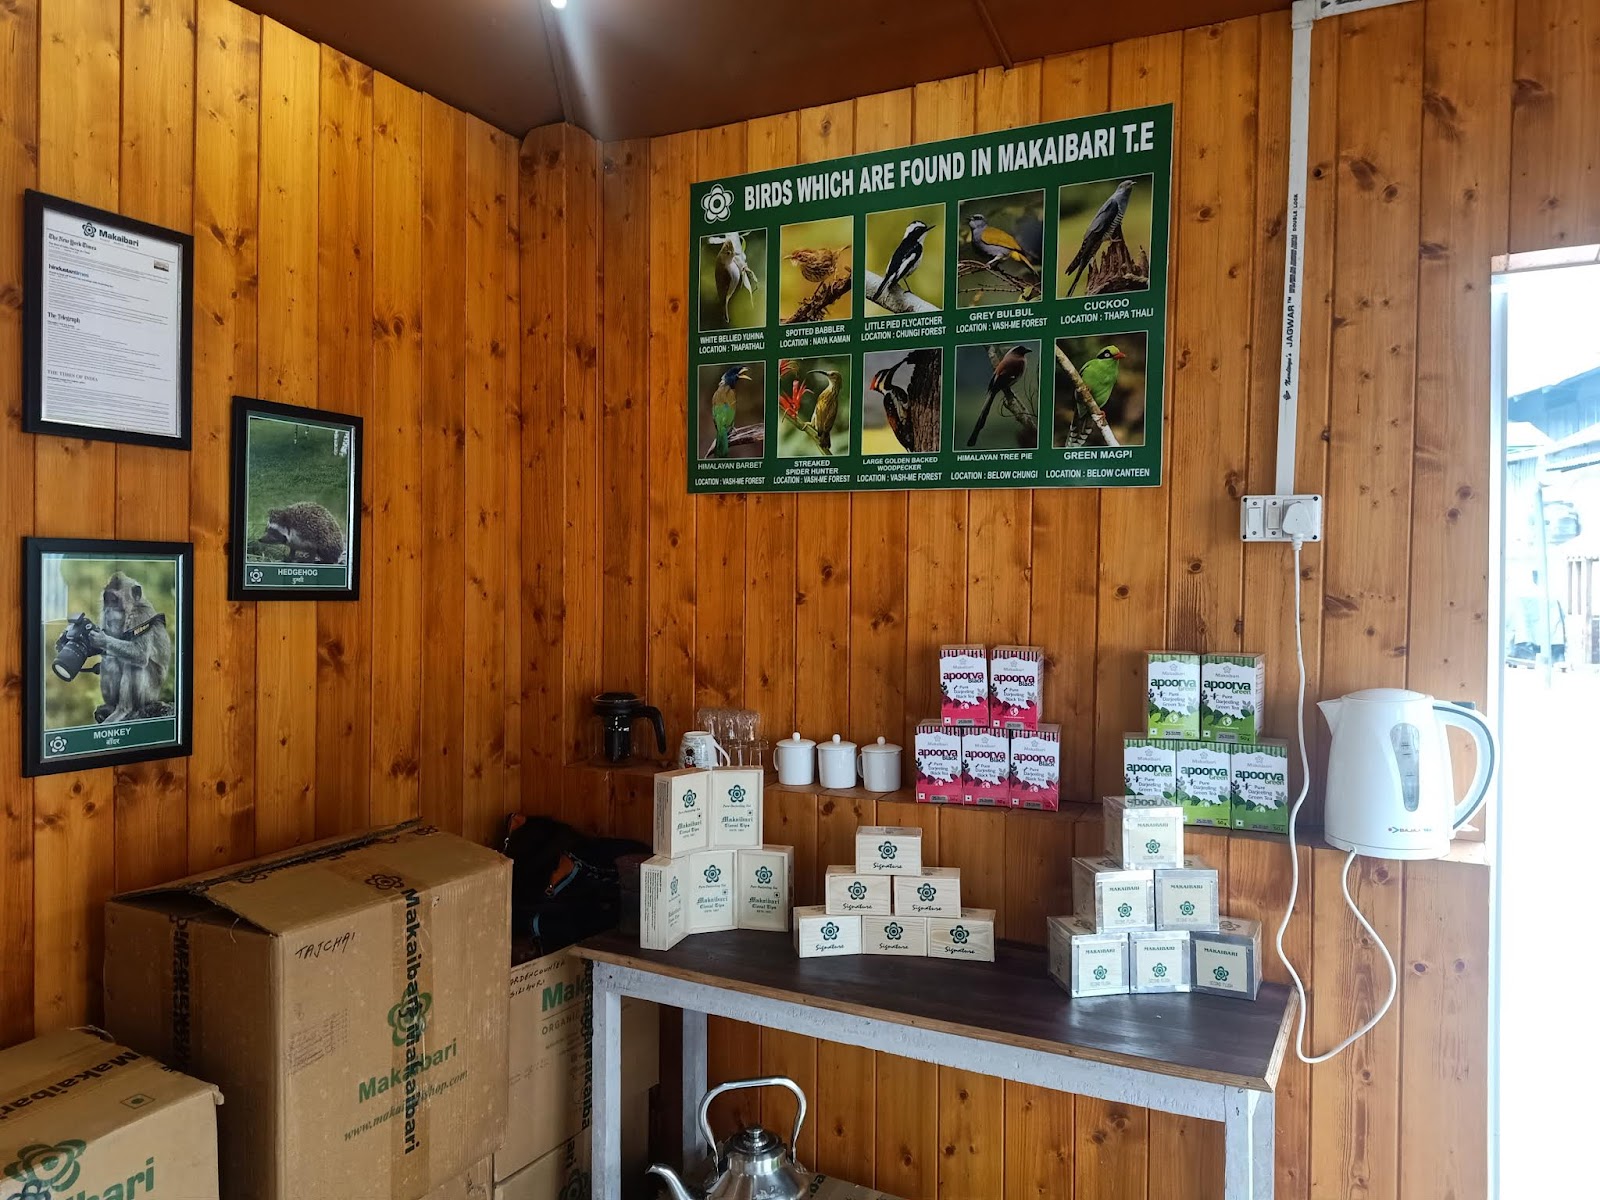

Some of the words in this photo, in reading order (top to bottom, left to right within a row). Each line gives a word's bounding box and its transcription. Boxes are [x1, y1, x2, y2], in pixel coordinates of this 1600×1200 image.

[745, 180, 793, 211] BIRDS
[797, 169, 854, 203] WHICH
[859, 163, 895, 194] ARE
[900, 152, 965, 188] FOUND
[972, 147, 991, 177] IN
[998, 127, 1115, 173] MAKAIBARI
[1122, 121, 1154, 153] T.E
[99, 229, 139, 247] Makaibari
[1084, 298, 1130, 311] CUCKOO
[47, 312, 56, 320] The
[969, 311, 995, 322] GREY
[997, 308, 1034, 319] BULBUL
[1060, 313, 1098, 324] LOCATION
[1104, 311, 1130, 321] THAPA
[1131, 308, 1154, 318] THALI
[864, 320, 886, 332] LITTLE
[886, 319, 900, 329] PIED
[902, 316, 943, 328] FLYCATCHER
[956, 322, 988, 334] LOCATION
[992, 320, 1020, 331] VASH-ME
[1022, 318, 1048, 328] FOREST
[786, 327, 814, 337] SPOTTED
[815, 324, 846, 334] BABBLER
[861, 330, 892, 342] LOCATION
[896, 328, 920, 339] CHUNGI
[921, 326, 946, 336] FOREST
[700, 334, 718, 344] WHITE
[718, 333, 742, 343] BELLIED
[742, 332, 764, 341] YUHINA
[780, 337, 808, 348] LOCATION
[812, 336, 829, 346] NAYA
[828, 334, 851, 344] KAMAN
[699, 344, 727, 354] LOCATION
[730, 342, 766, 352] THAPATHALI
[911, 456, 938, 464] BACKED
[957, 454, 999, 462] HIMALAYAN
[1020, 452, 1033, 460] PIE
[1064, 450, 1098, 460] GREEN
[1100, 450, 1133, 459] MAGPI
[698, 462, 735, 470] HIMALAYAN
[736, 461, 763, 469] BARBET
[794, 460, 830, 468] STREAKED
[786, 468, 810, 476] SPIDER
[857, 474, 886, 482] LOCATION
[890, 472, 918, 482] VASH-ME
[918, 472, 942, 481] FOREST
[951, 472, 983, 480] LOCATION
[987, 471, 1012, 480] BELOW
[1012, 470, 1038, 479] CHUNGI
[1046, 469, 1082, 478] LOCATION
[1086, 468, 1114, 478] BELOW
[1114, 468, 1150, 477] CANTEEN
[695, 478, 720, 486] LOCATION
[722, 477, 745, 486] VASH-ME
[745, 476, 766, 485] FOREST
[774, 476, 800, 484] LOCATION
[804, 476, 828, 484] VASH-ME
[828, 474, 851, 483] FOREST
[278, 568, 318, 576] HEDGEHOG
[943, 672, 984, 682] apoorva
[994, 674, 1034, 684] apoorva
[1150, 678, 1196, 690] apoorva
[1204, 680, 1251, 692] apoorva
[94, 728, 132, 739] MONKEY
[918, 748, 958, 760] apoorva
[964, 750, 1006, 762] apoorva
[1013, 752, 1056, 764] apoorva
[1126, 764, 1172, 775] apoorva
[1180, 766, 1228, 778] apoorva
[1235, 770, 1284, 782] apoorva
[873, 862, 902, 870] Signature
[843, 902, 872, 911] Signature
[912, 904, 942, 912] Signature
[816, 944, 844, 952] Signature
[879, 943, 908, 951] Signature
[944, 946, 976, 954] Signature
[1204, 947, 1238, 957] MAKAIBARI
